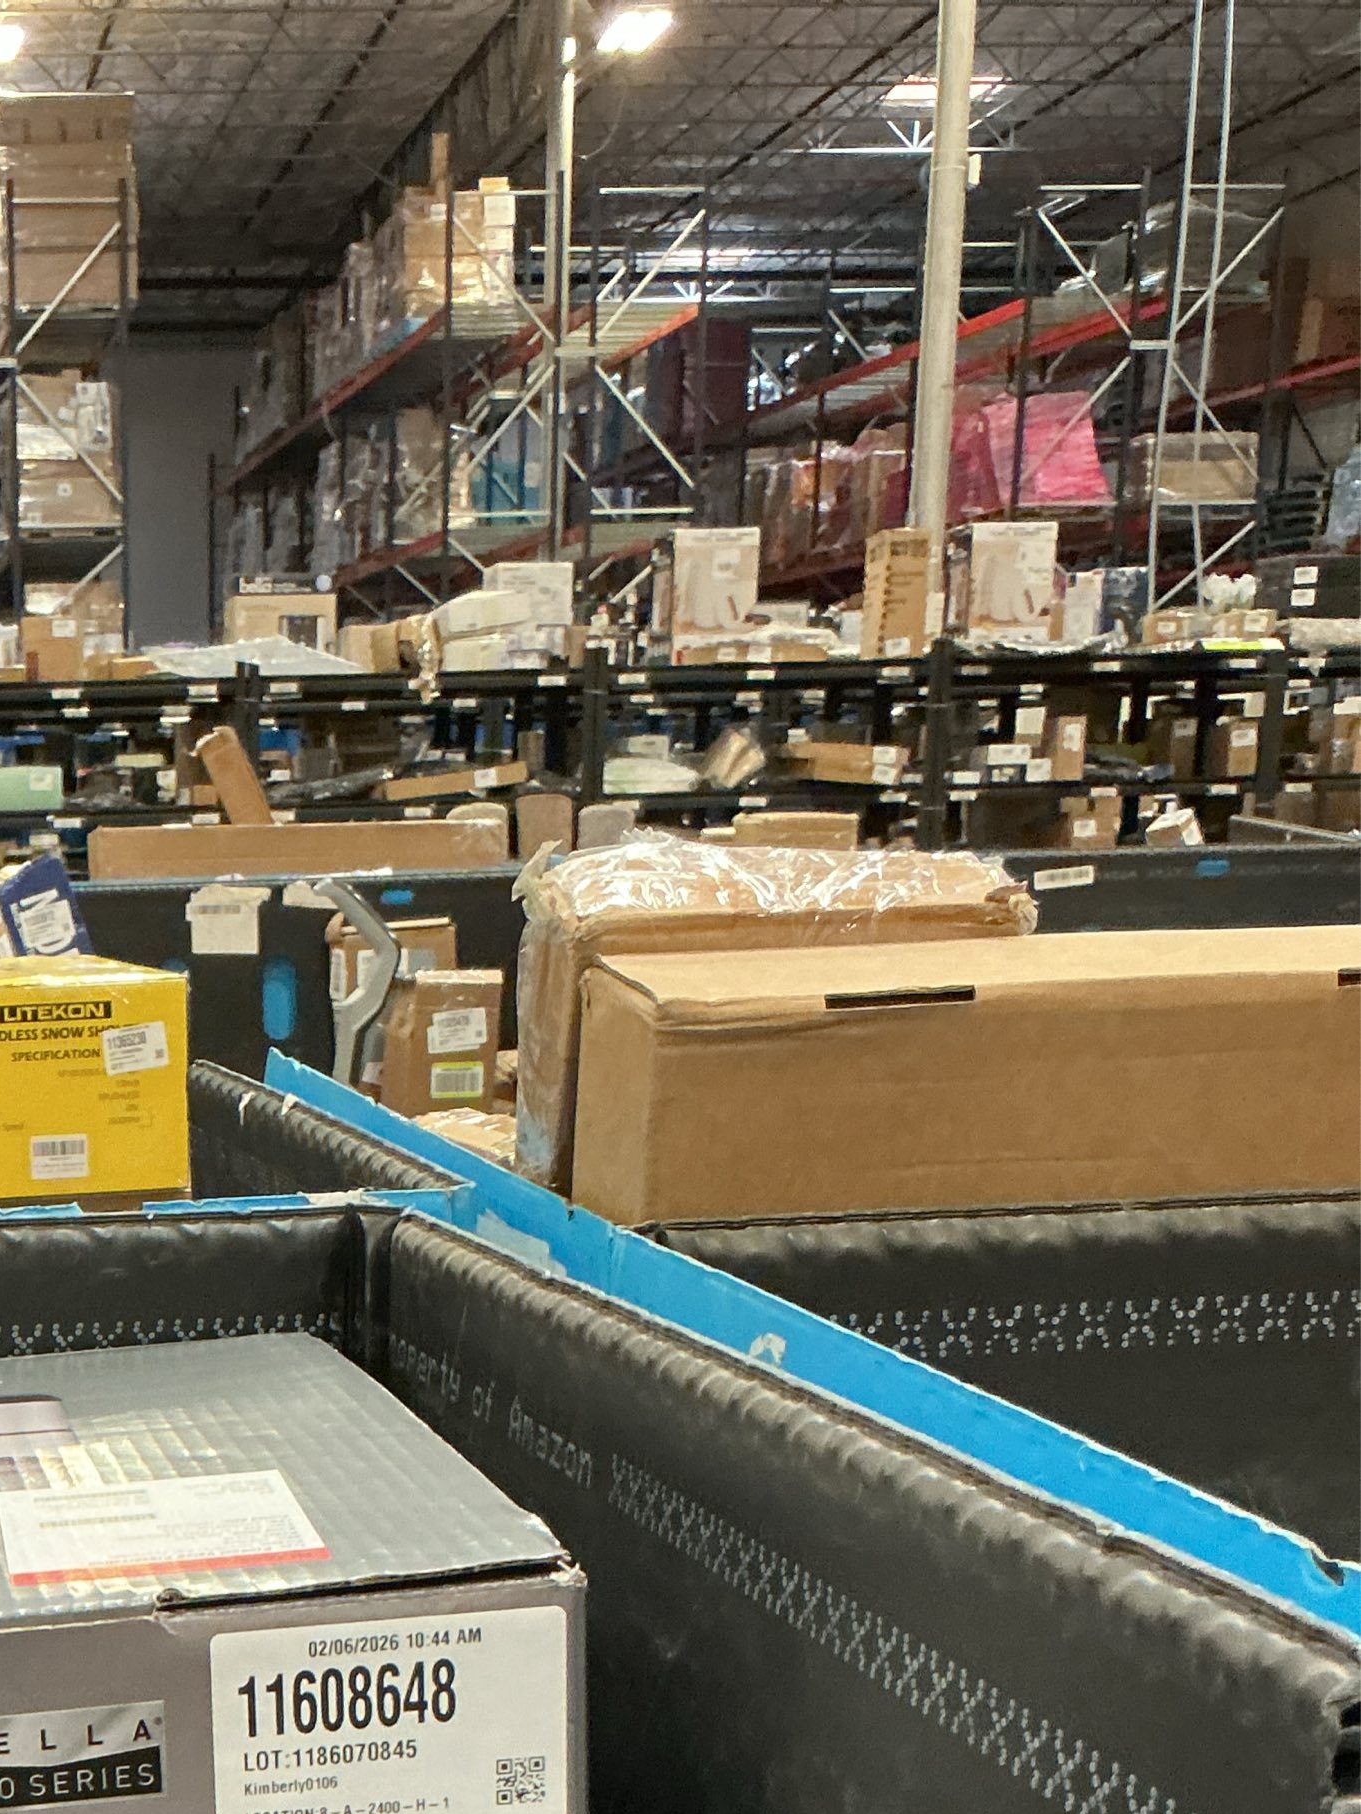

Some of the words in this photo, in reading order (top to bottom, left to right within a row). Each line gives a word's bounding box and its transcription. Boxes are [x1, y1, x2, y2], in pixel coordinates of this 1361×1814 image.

[3, 1003, 105, 1022] LITEKON
[41, 1026, 84, 1040] SNOW
[472, 1382, 496, 1424] of
[509, 1395, 593, 1489] Amazon
[308, 1634, 400, 1658] 02/06/2026
[406, 1630, 451, 1650] 10:44
[456, 1627, 482, 1645] AM
[238, 1658, 457, 1737] 11608648
[243, 1740, 418, 1774] LOT:1186070845
[28, 1763, 156, 1797] SERIES
[244, 1776, 339, 1796] Kimberly0106
